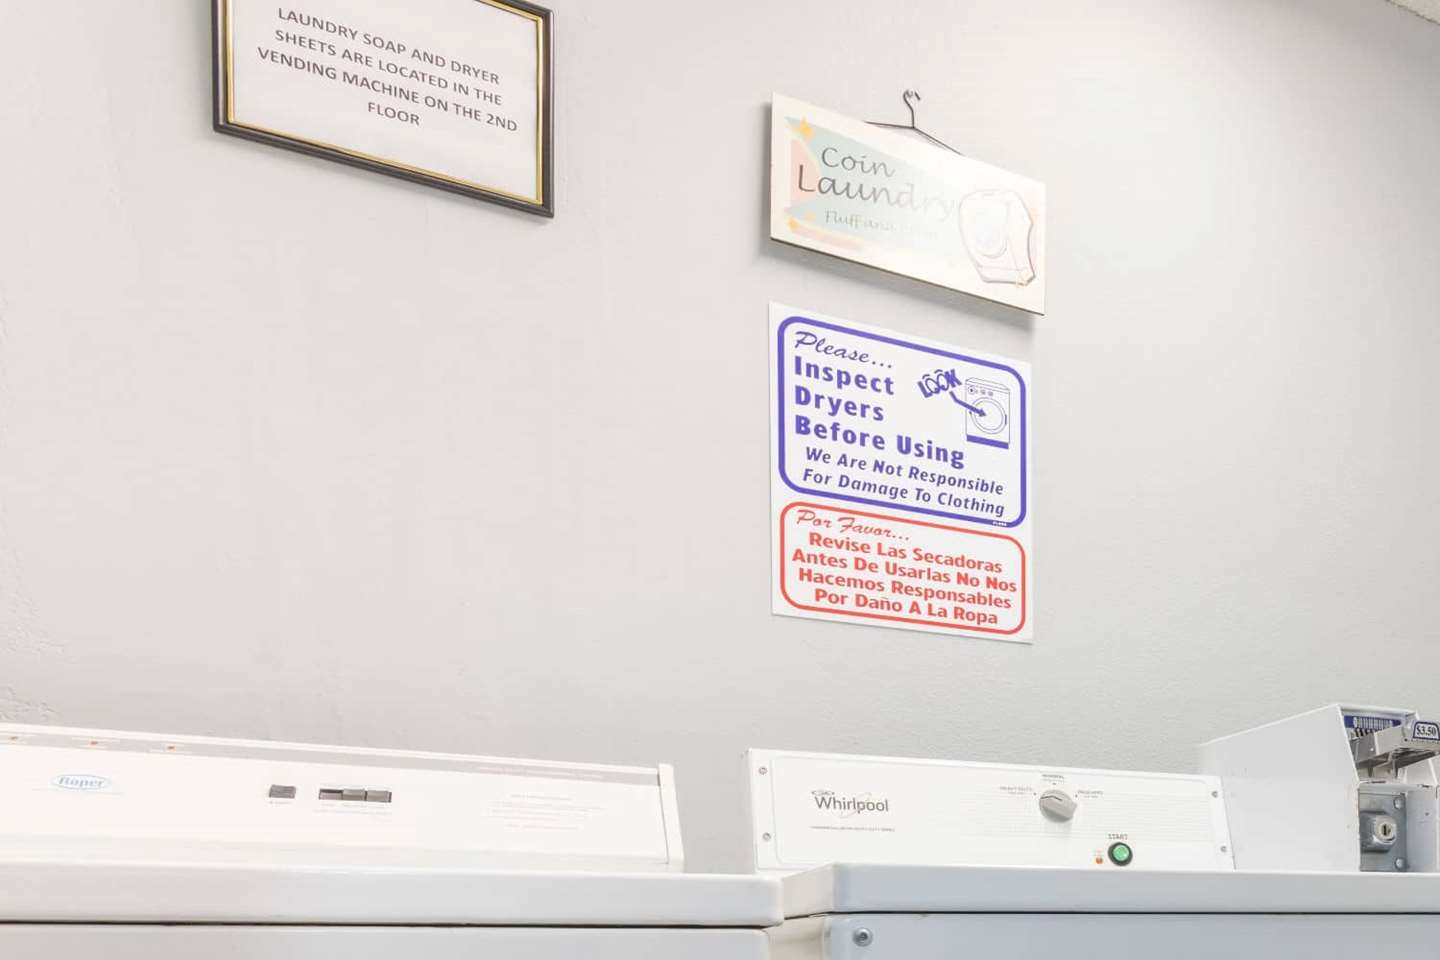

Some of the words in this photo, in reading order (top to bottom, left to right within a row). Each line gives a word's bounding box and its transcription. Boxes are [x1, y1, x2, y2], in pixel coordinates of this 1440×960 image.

[278, 7, 358, 41] LAUNDRY
[363, 33, 406, 54] SOAP
[412, 48, 446, 68] AND
[451, 60, 499, 85] DRYER
[275, 30, 336, 56] SHEETS
[342, 49, 373, 67] ARE
[379, 59, 448, 89] LOCATED
[453, 82, 469, 96] IN
[473, 87, 502, 106] THE
[258, 47, 336, 80] VENDING
[343, 71, 419, 104] MACHINE
[425, 96, 448, 112] ON
[453, 103, 481, 121] THE
[487, 113, 517, 132] 2ND
[368, 102, 420, 126] FLOOR
[822, 147, 895, 177] Coin
[798, 165, 953, 223] Laundry
[795, 356, 895, 395] Inspect
[918, 369, 962, 398] LOOK
[795, 385, 884, 421] Dryers
[795, 415, 885, 450] Before
[897, 435, 964, 470] Using
[806, 446, 831, 464] We
[837, 454, 866, 470] Are
[872, 459, 903, 477] Not
[908, 466, 1004, 495] Responsible
[803, 468, 832, 485] For
[838, 474, 909, 500] Damage
[915, 488, 931, 502] To
[937, 492, 1005, 518] Clothing
[796, 509, 832, 529] Por
[791, 548, 848, 569] Antes
[854, 558, 879, 573] De
[885, 561, 951, 583] Usarlas
[956, 573, 980, 587] No
[986, 577, 1017, 593] Nos
[808, 532, 871, 554] Revise
[877, 542, 907, 559] Las
[913, 548, 1002, 574] Secadoras
[798, 568, 885, 592] Hacemos
[891, 580, 1012, 609] Responsables
[815, 588, 848, 605] Por
[855, 594, 902, 613] Daño
[908, 600, 922, 615] A
[927, 603, 948, 618] La
[953, 608, 998, 626] Ropa
[814, 797, 889, 814] Whirlpool
